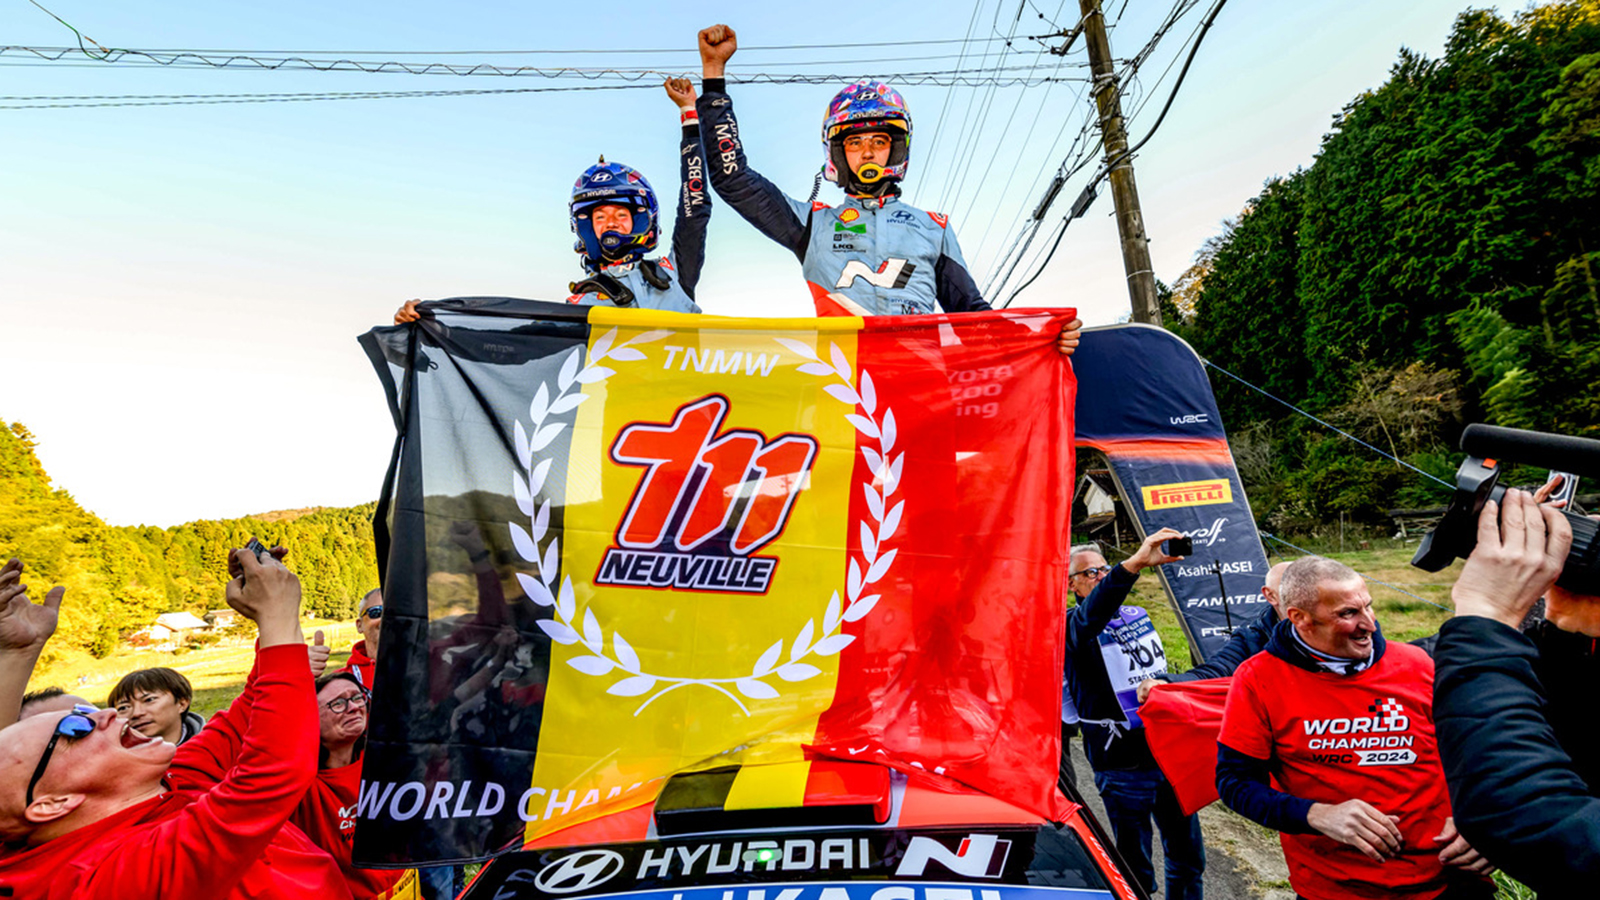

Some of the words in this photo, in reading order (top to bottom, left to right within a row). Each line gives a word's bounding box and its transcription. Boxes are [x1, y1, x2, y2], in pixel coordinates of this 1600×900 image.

[714, 123, 739, 175] MOBIS
[687, 155, 705, 206] MOBIS
[663, 345, 780, 377] TNMW
[1169, 413, 1208, 425] WRC
[1150, 483, 1224, 506] PIRELLI
[594, 551, 779, 593] NEUVILLE
[1303, 715, 1410, 736] WORLD
[1308, 735, 1415, 750] CHAMPION
[1311, 753, 1353, 764] WRC
[1366, 751, 1410, 763] 2024
[357, 779, 506, 822] WORLD
[635, 838, 870, 880] HYUNDAI
